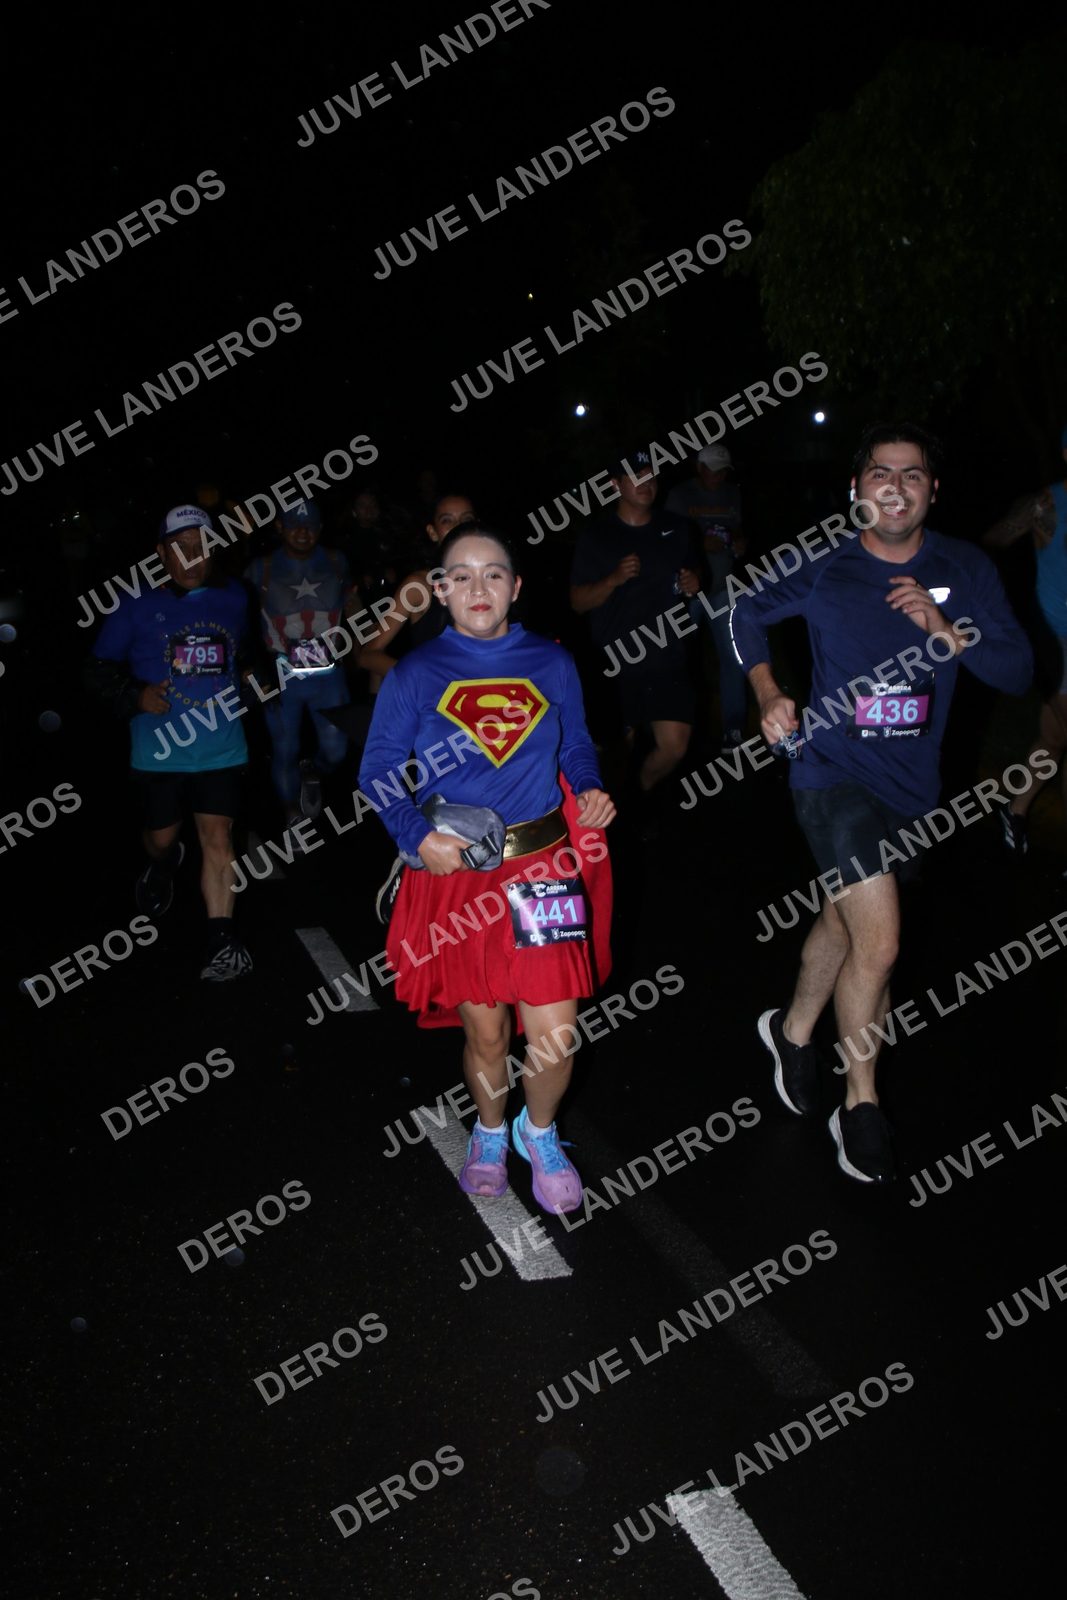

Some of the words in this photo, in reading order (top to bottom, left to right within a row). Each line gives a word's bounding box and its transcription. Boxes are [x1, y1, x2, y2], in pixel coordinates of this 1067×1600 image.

[183, 646, 218, 664] 795
[866, 699, 919, 724] 436
[532, 898, 578, 925] 441
